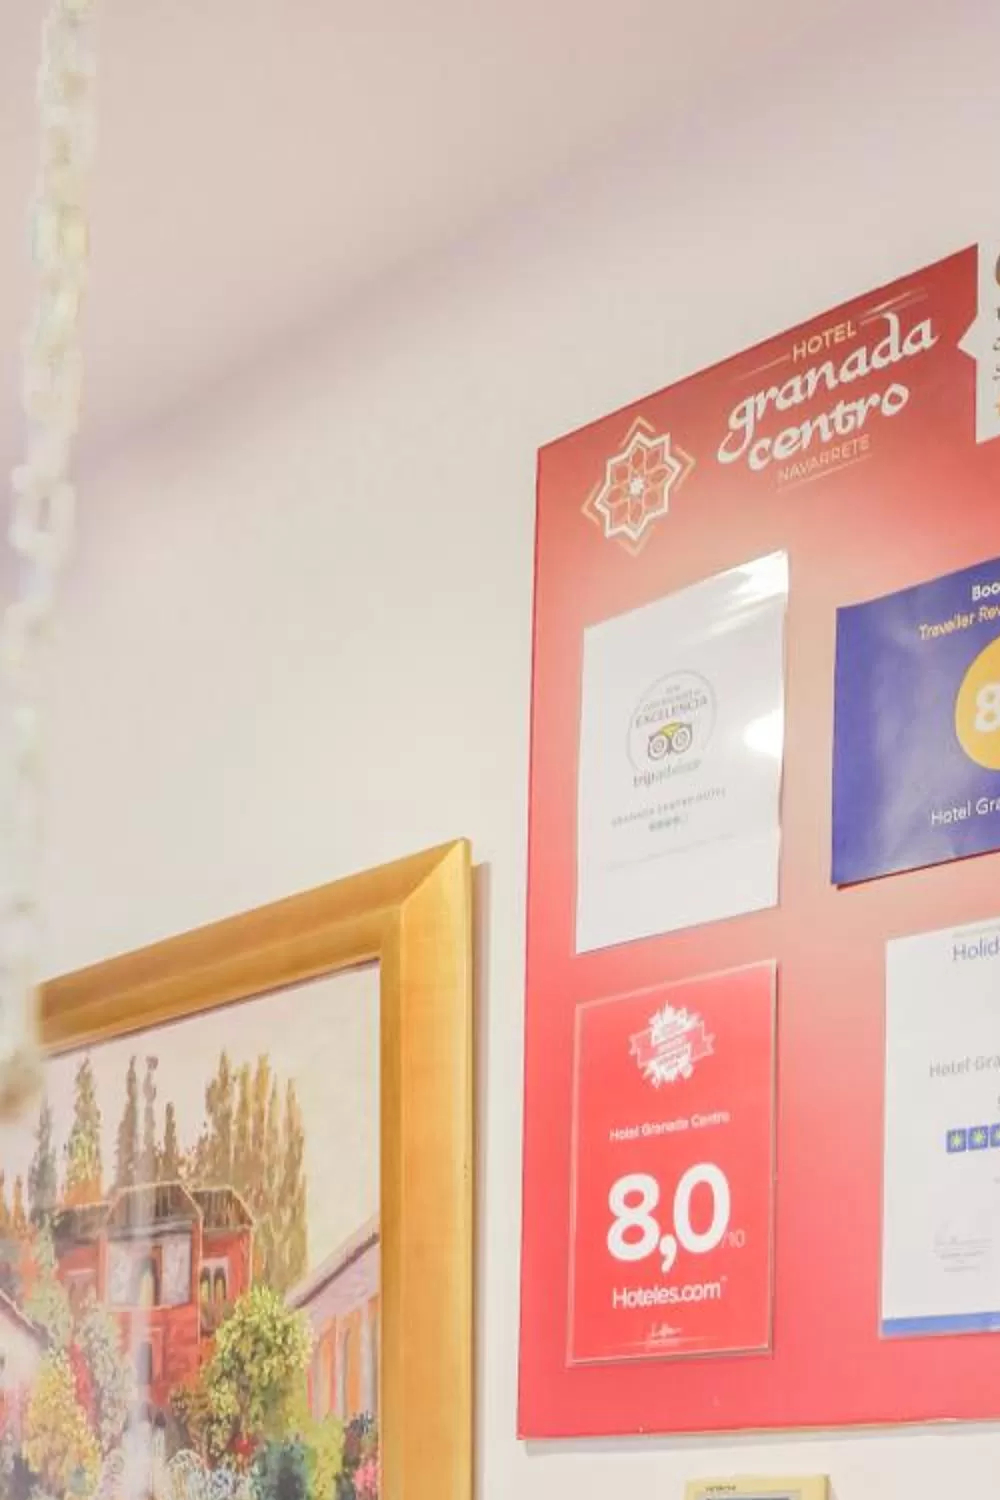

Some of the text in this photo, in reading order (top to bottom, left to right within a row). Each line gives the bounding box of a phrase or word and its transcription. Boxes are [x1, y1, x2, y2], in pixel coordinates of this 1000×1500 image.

[793, 320, 857, 364] HOTEL
[717, 312, 939, 464] granada
[748, 382, 909, 471] centro
[776, 433, 870, 482] NAVARRETE
[919, 610, 976, 641] Traveller
[930, 799, 972, 826] Hotel
[929, 1056, 970, 1079] Hotel
[607, 1161, 731, 1274] 8,0
[612, 1280, 722, 1310] Hoteles.com
